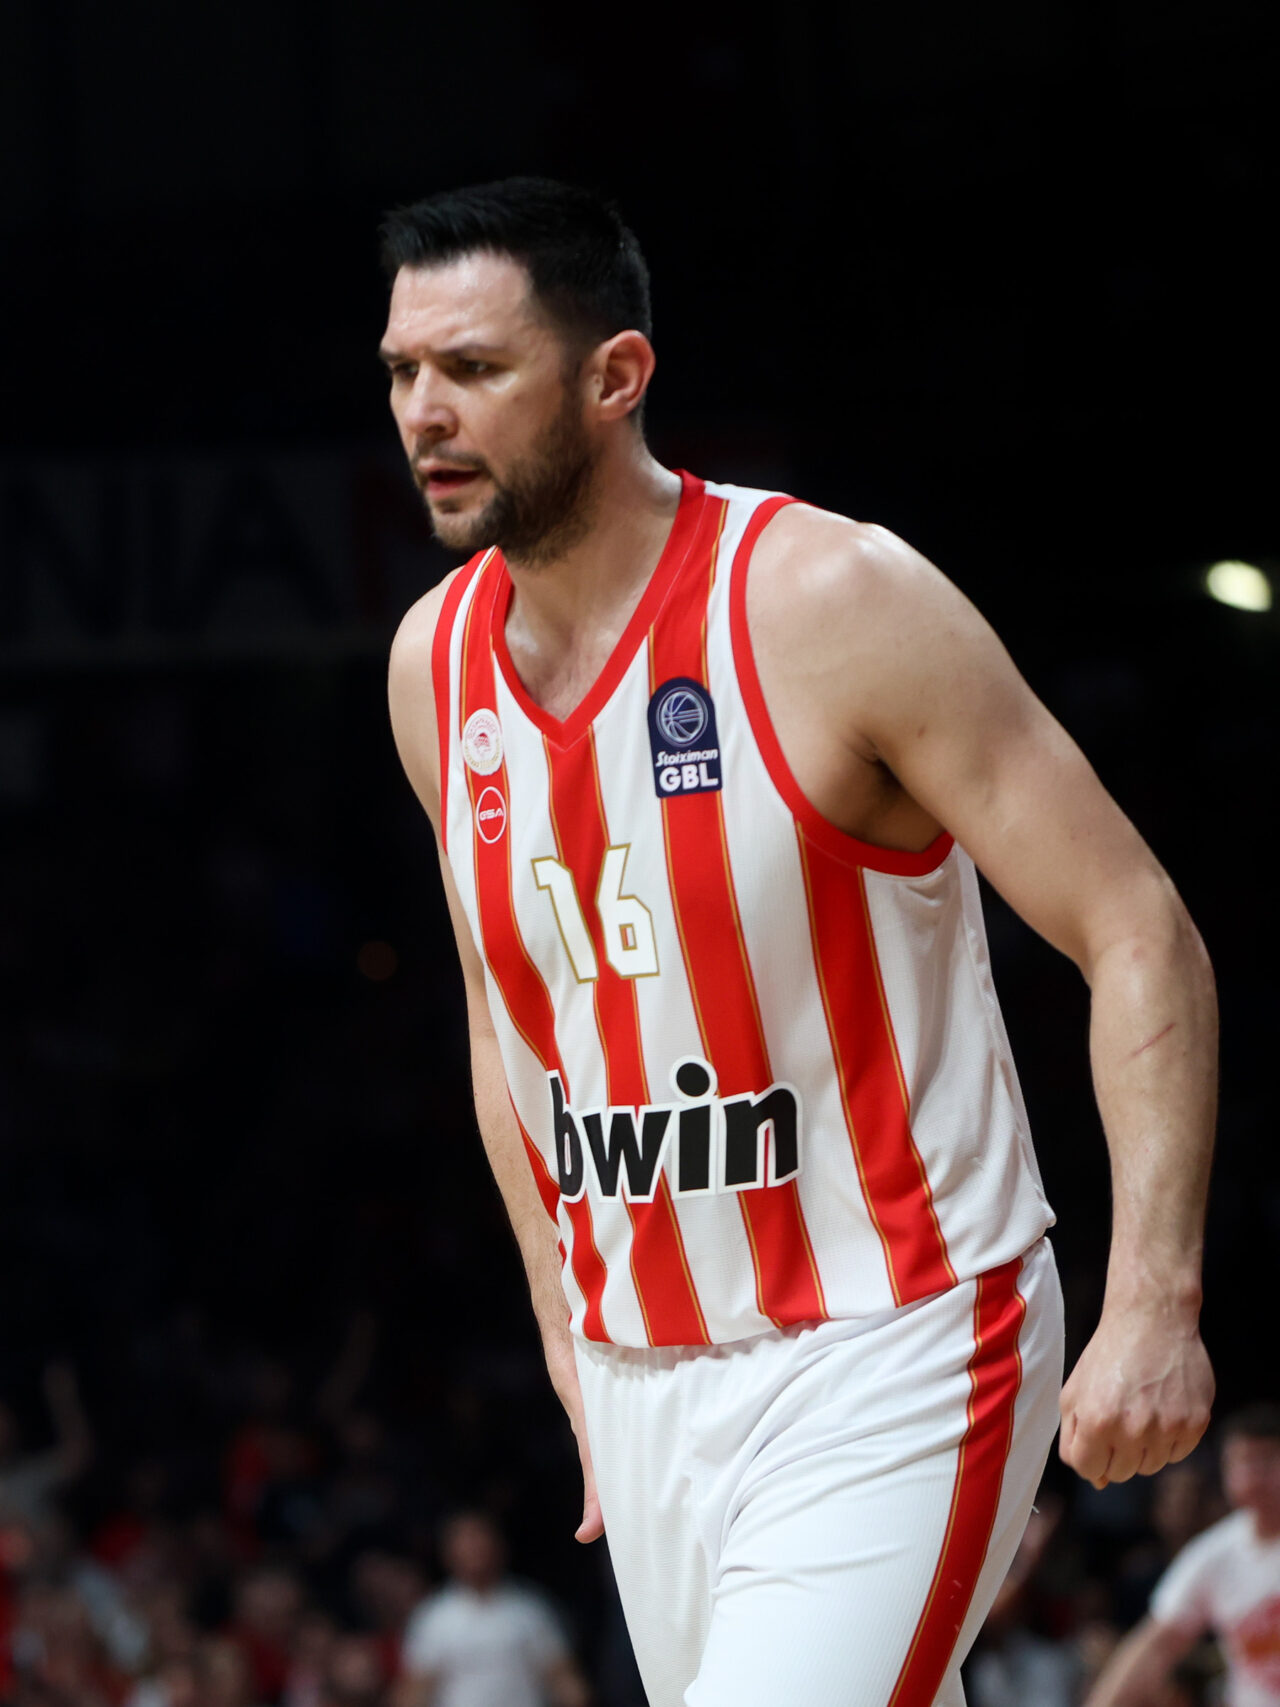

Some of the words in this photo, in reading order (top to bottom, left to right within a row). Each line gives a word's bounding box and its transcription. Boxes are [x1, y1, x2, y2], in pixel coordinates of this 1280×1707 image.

[655, 748, 719, 768] Stoiximan
[658, 762, 719, 793] GBL
[530, 842, 661, 984] 16
[547, 1056, 803, 1202] bwin
